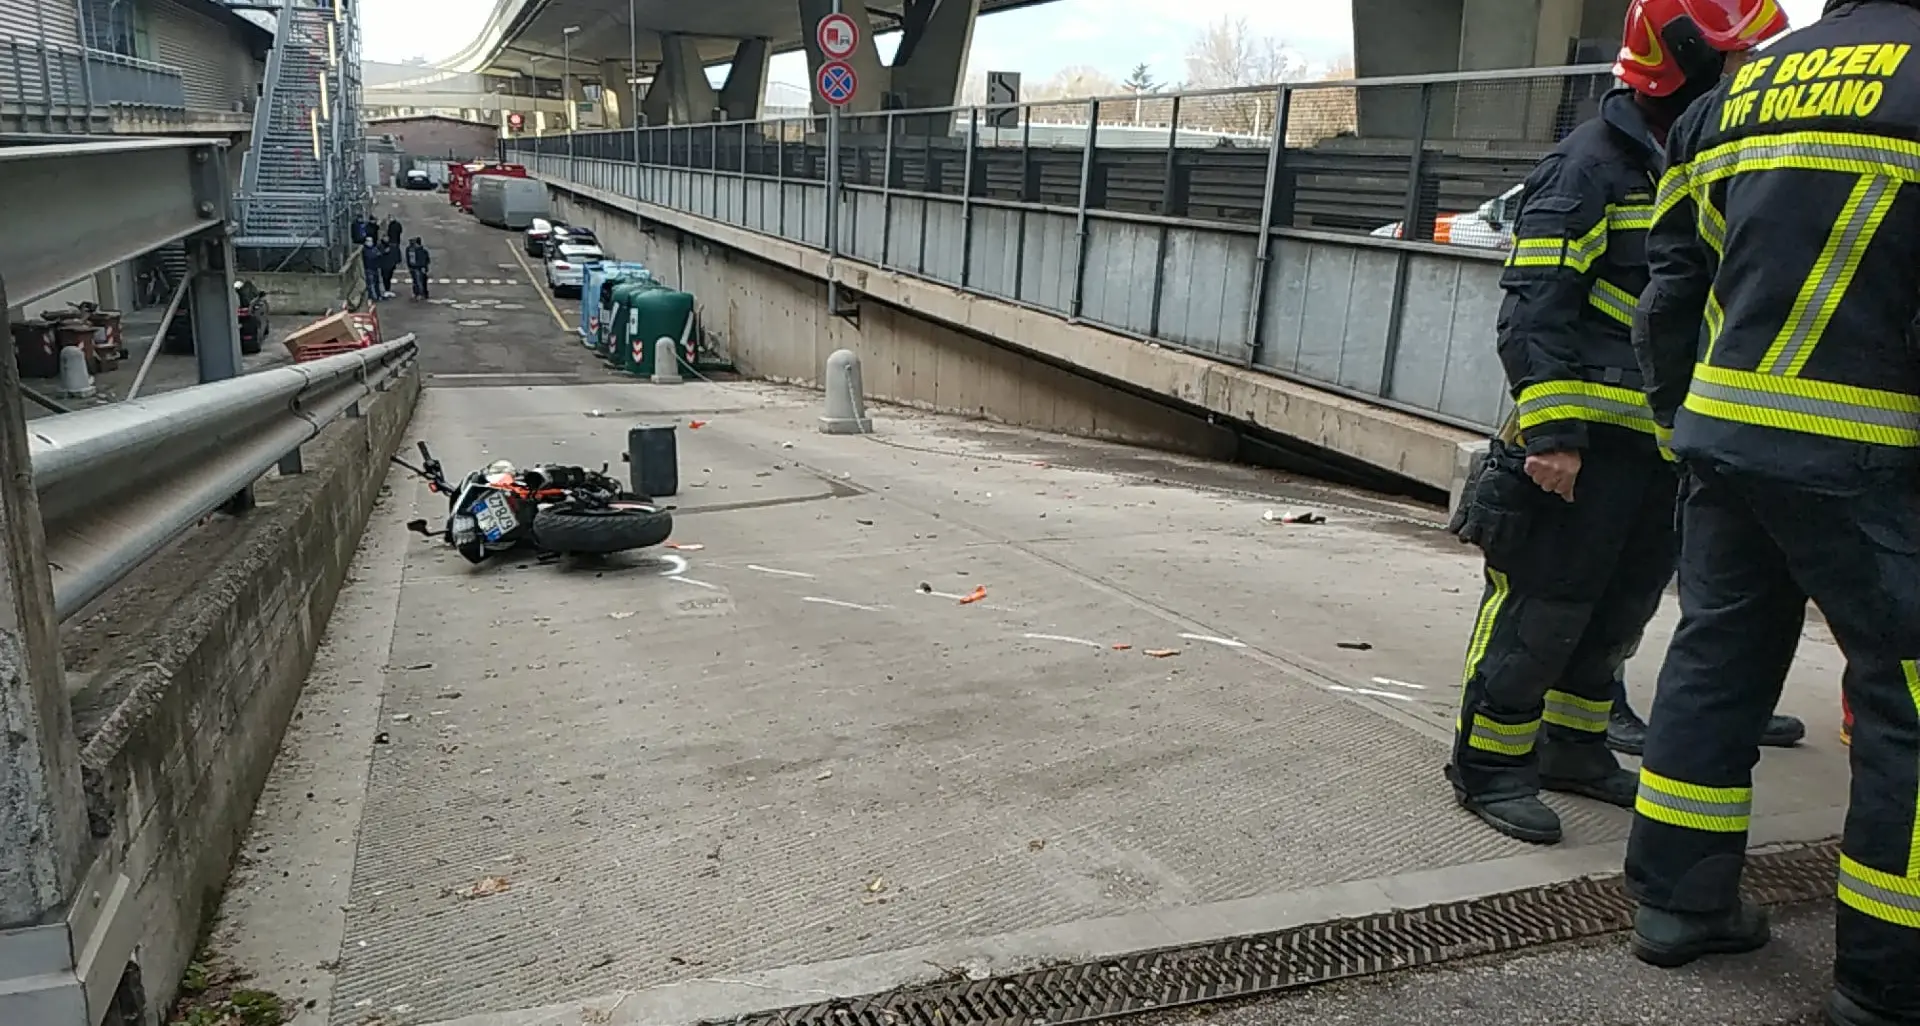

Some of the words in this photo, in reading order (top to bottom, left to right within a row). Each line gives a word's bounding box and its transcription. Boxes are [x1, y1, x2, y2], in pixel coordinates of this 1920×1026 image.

[1729, 56, 1775, 95] BF
[1773, 44, 1911, 84] BOZEN
[1720, 90, 1760, 131] VVF
[1759, 79, 1883, 123] BOLZANO
